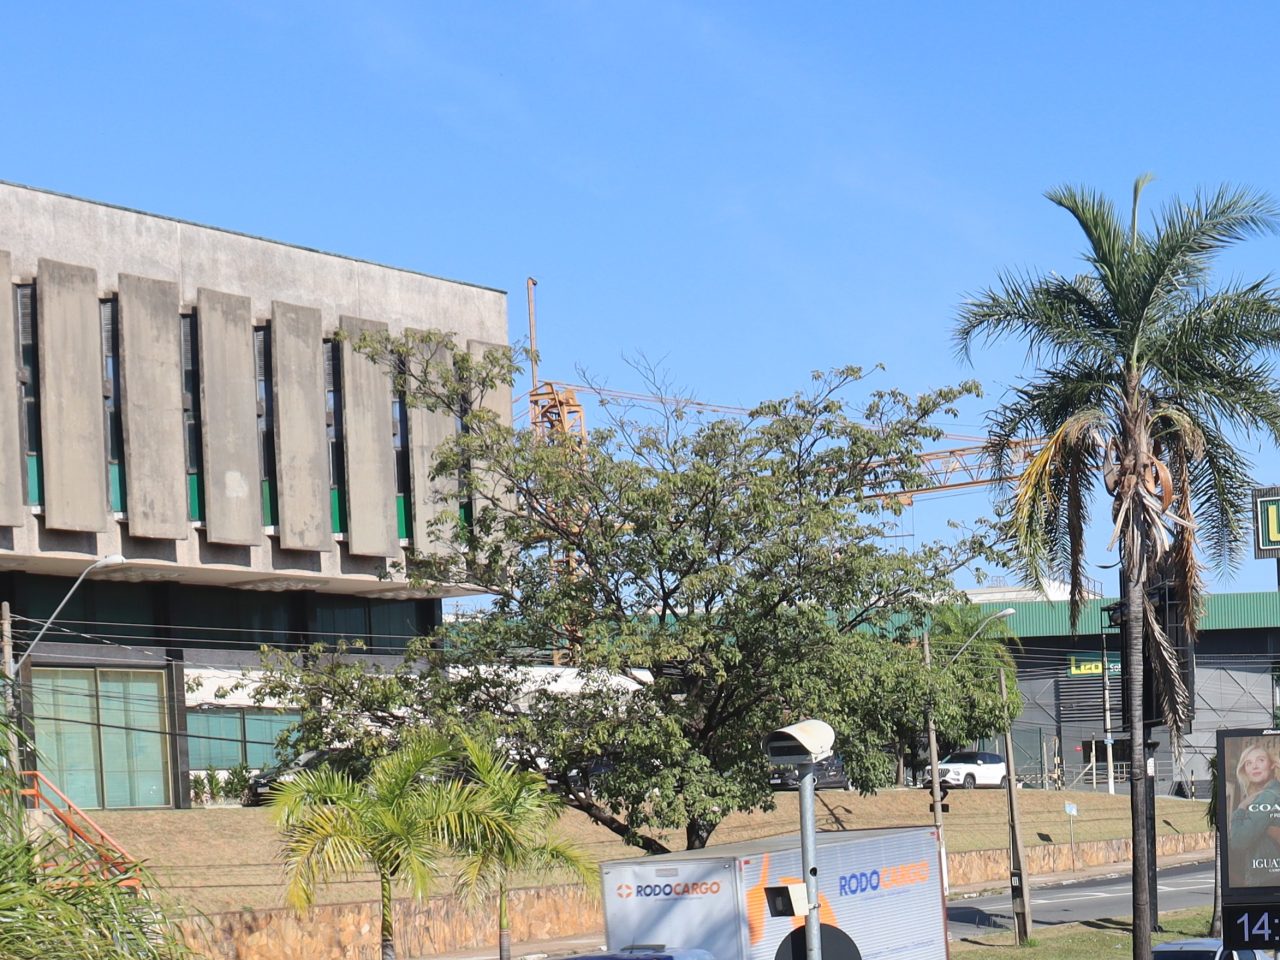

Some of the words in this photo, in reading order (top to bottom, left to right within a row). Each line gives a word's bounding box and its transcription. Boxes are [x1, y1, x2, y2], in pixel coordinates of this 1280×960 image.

[1071, 656, 1103, 675] Leo
[839, 860, 930, 896] RODOCARGO
[636, 881, 721, 897] RODOCARGO
